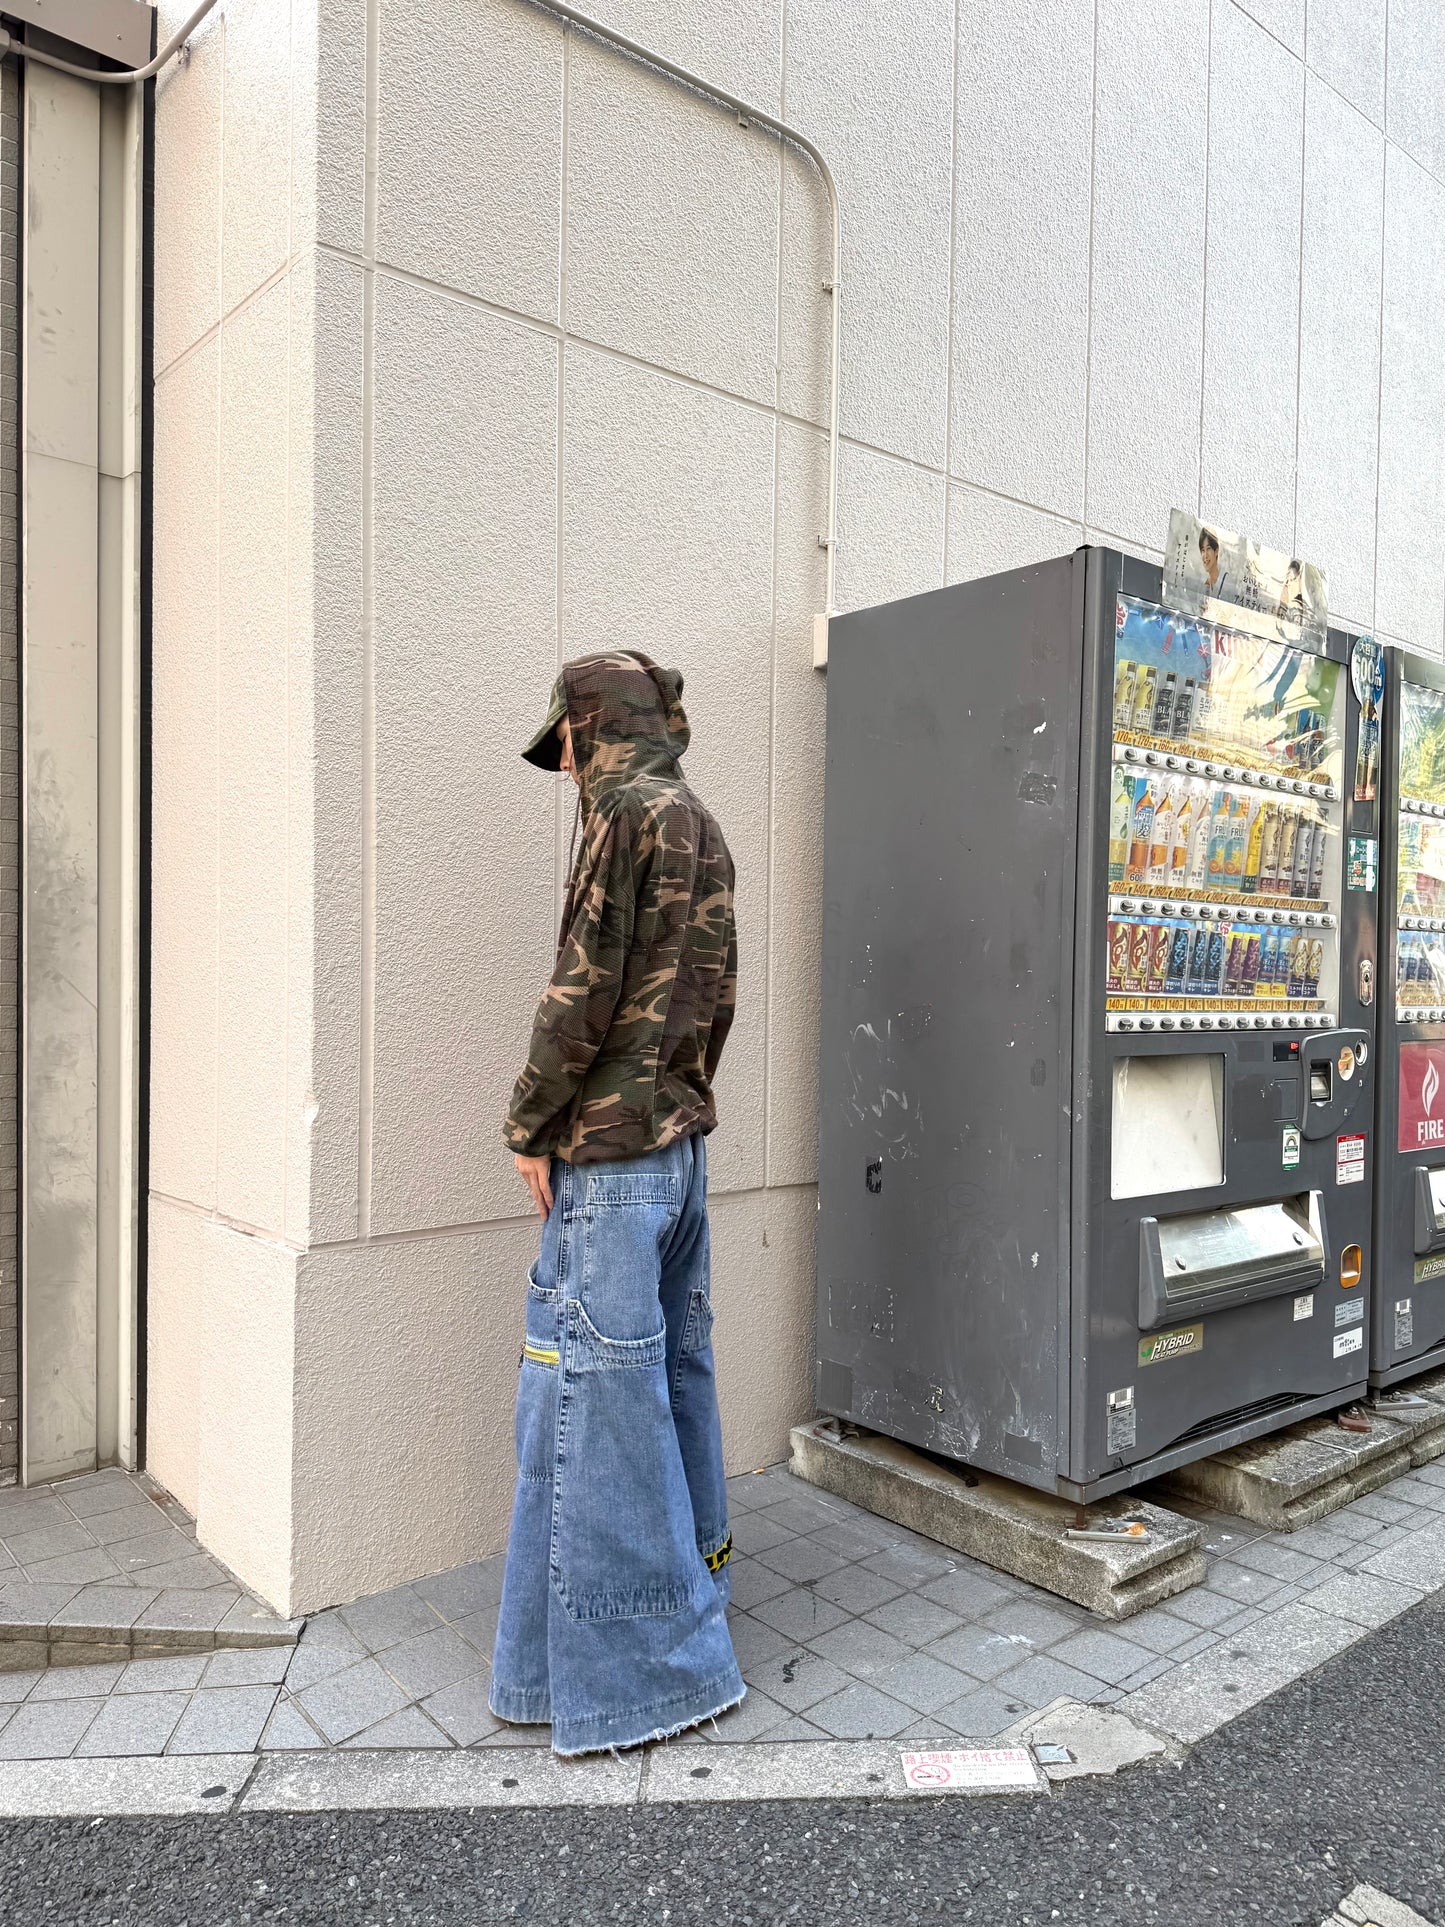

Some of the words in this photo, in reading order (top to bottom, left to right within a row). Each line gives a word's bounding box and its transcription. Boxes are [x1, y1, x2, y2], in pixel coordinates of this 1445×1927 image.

[1417, 1119, 1445, 1142] FIRE
[1421, 1260, 1445, 1279] HYBRI
[1150, 1332, 1194, 1361] HYBRID
